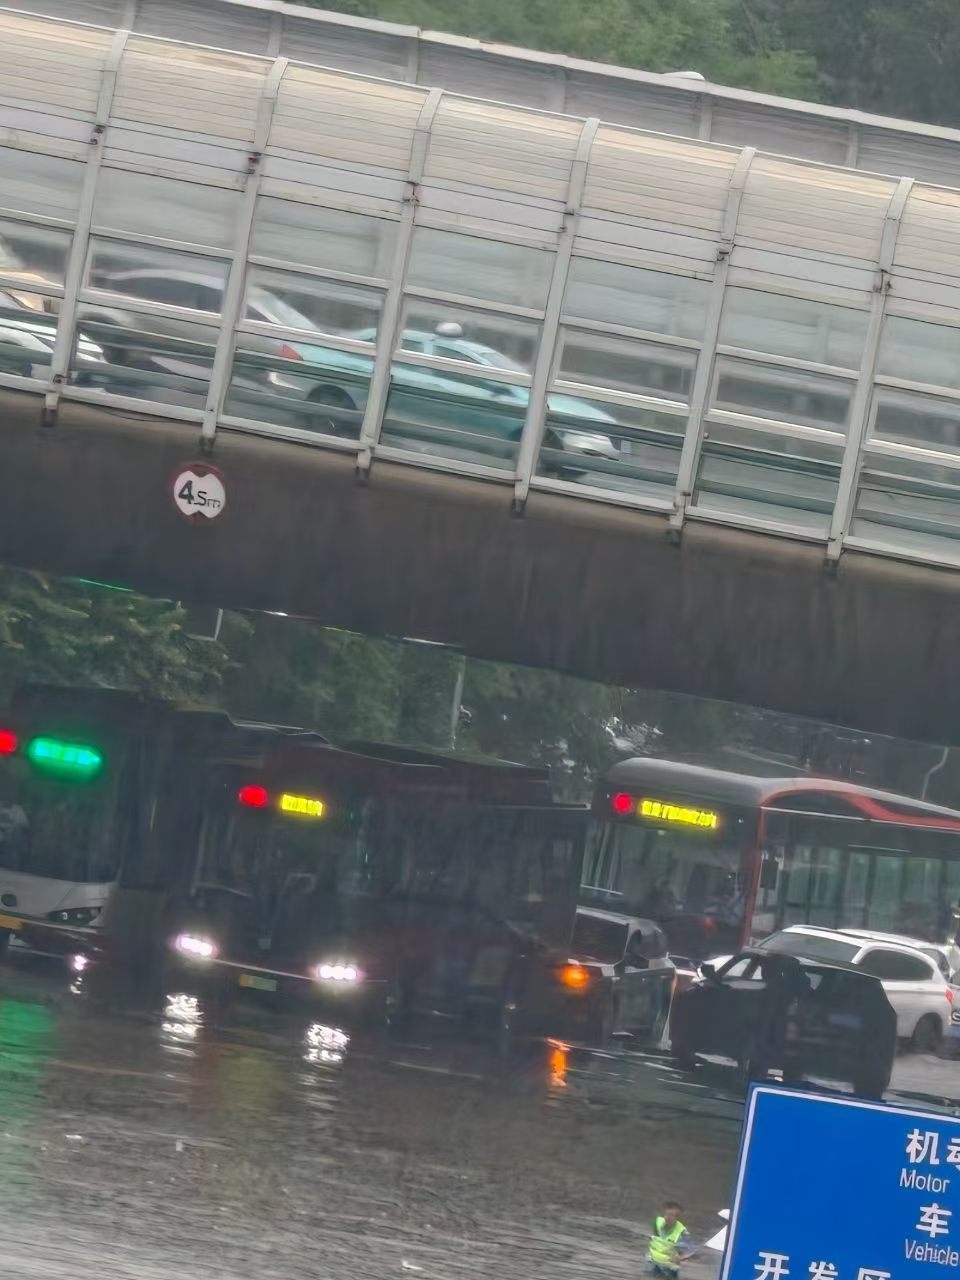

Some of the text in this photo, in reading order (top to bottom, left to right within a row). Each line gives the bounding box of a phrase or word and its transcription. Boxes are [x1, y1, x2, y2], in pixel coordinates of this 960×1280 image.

[899, 1168, 951, 1193] Motor
[916, 1202, 952, 1239] 车
[905, 1238, 959, 1267] Vehicle
